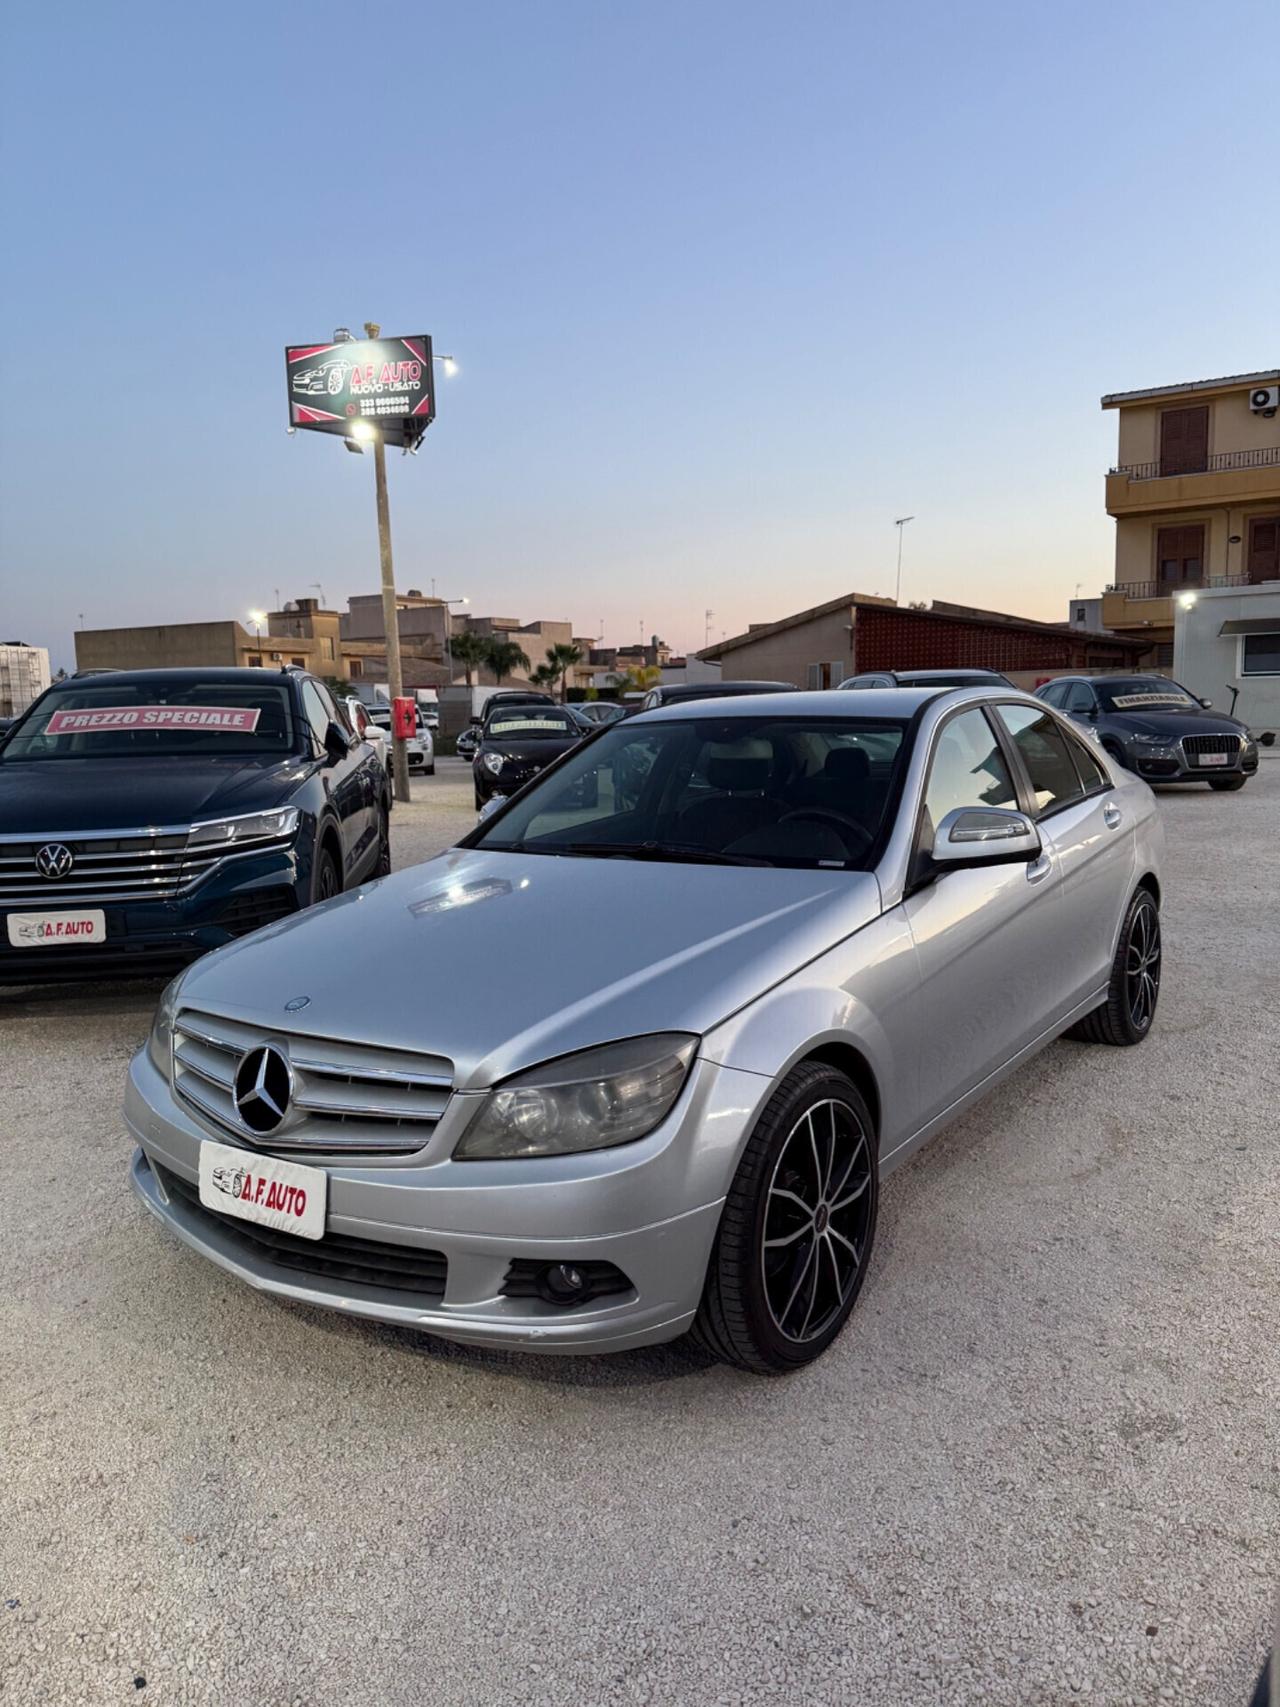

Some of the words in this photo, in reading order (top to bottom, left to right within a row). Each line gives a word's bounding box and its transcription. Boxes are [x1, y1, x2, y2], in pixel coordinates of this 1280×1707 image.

[379, 360, 421, 383] AUTO
[350, 383, 383, 395] NUOVO
[389, 381, 421, 391] USATO
[59, 710, 136, 729] PREZZO
[142, 710, 245, 726] SPECIALE
